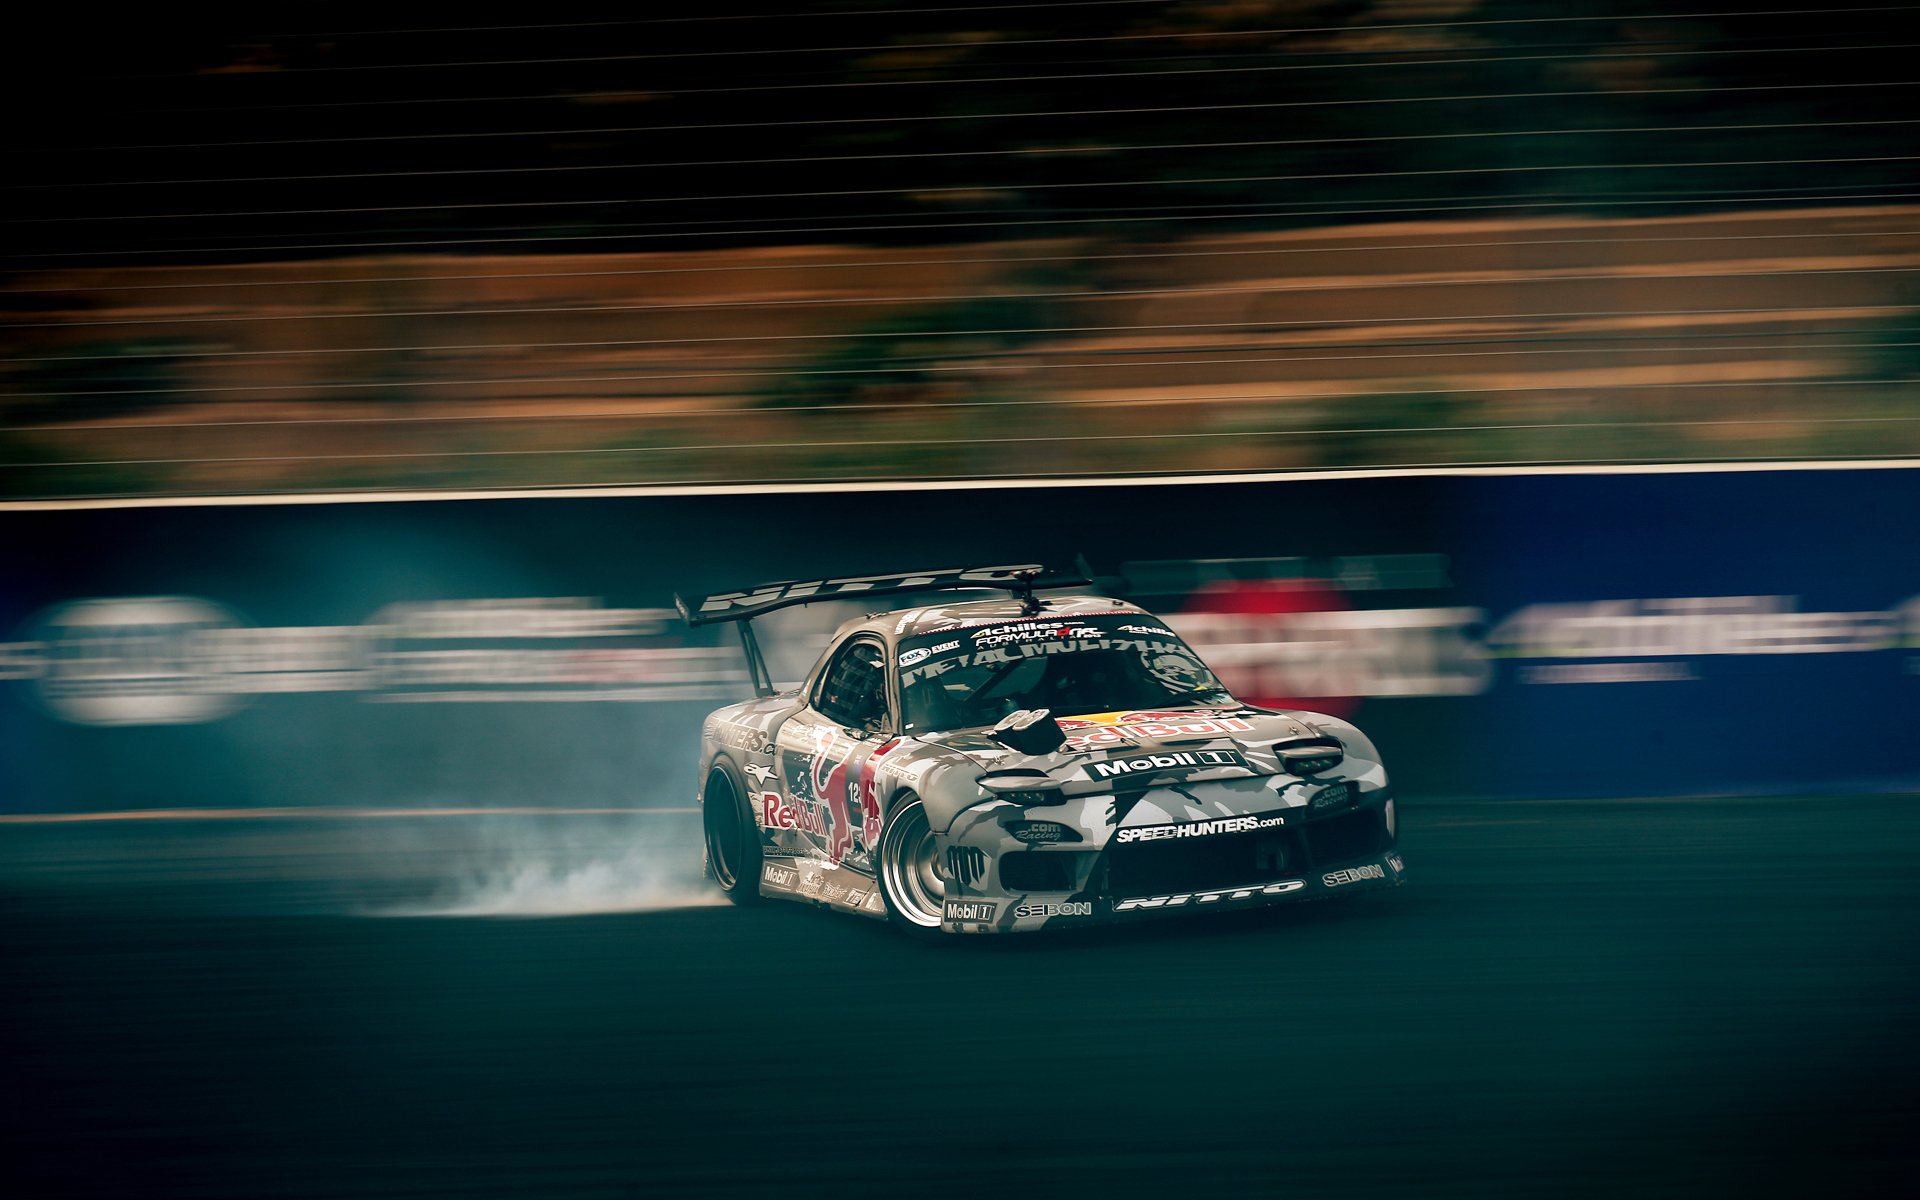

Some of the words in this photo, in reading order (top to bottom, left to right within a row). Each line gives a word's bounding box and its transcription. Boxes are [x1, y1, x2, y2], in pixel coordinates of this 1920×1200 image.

[700, 565, 1044, 612] NITTO
[970, 622, 1064, 639] Achilles
[900, 650, 922, 662] FOX
[931, 640, 960, 654] EVENT
[1128, 717, 1256, 738] Bull
[1094, 752, 1197, 777] Mobil
[762, 791, 802, 830] Red
[801, 799, 827, 837] Bull
[1015, 830, 1062, 841] Racing
[1027, 823, 1062, 833] .com
[1116, 816, 1285, 843] SPEEDHUNTERS.com
[764, 866, 789, 885] Mobil
[1322, 864, 1385, 887] SEIBON
[1113, 879, 1306, 912] NITTO
[947, 903, 978, 919] Mobil
[1014, 902, 1092, 919] SEIBON
